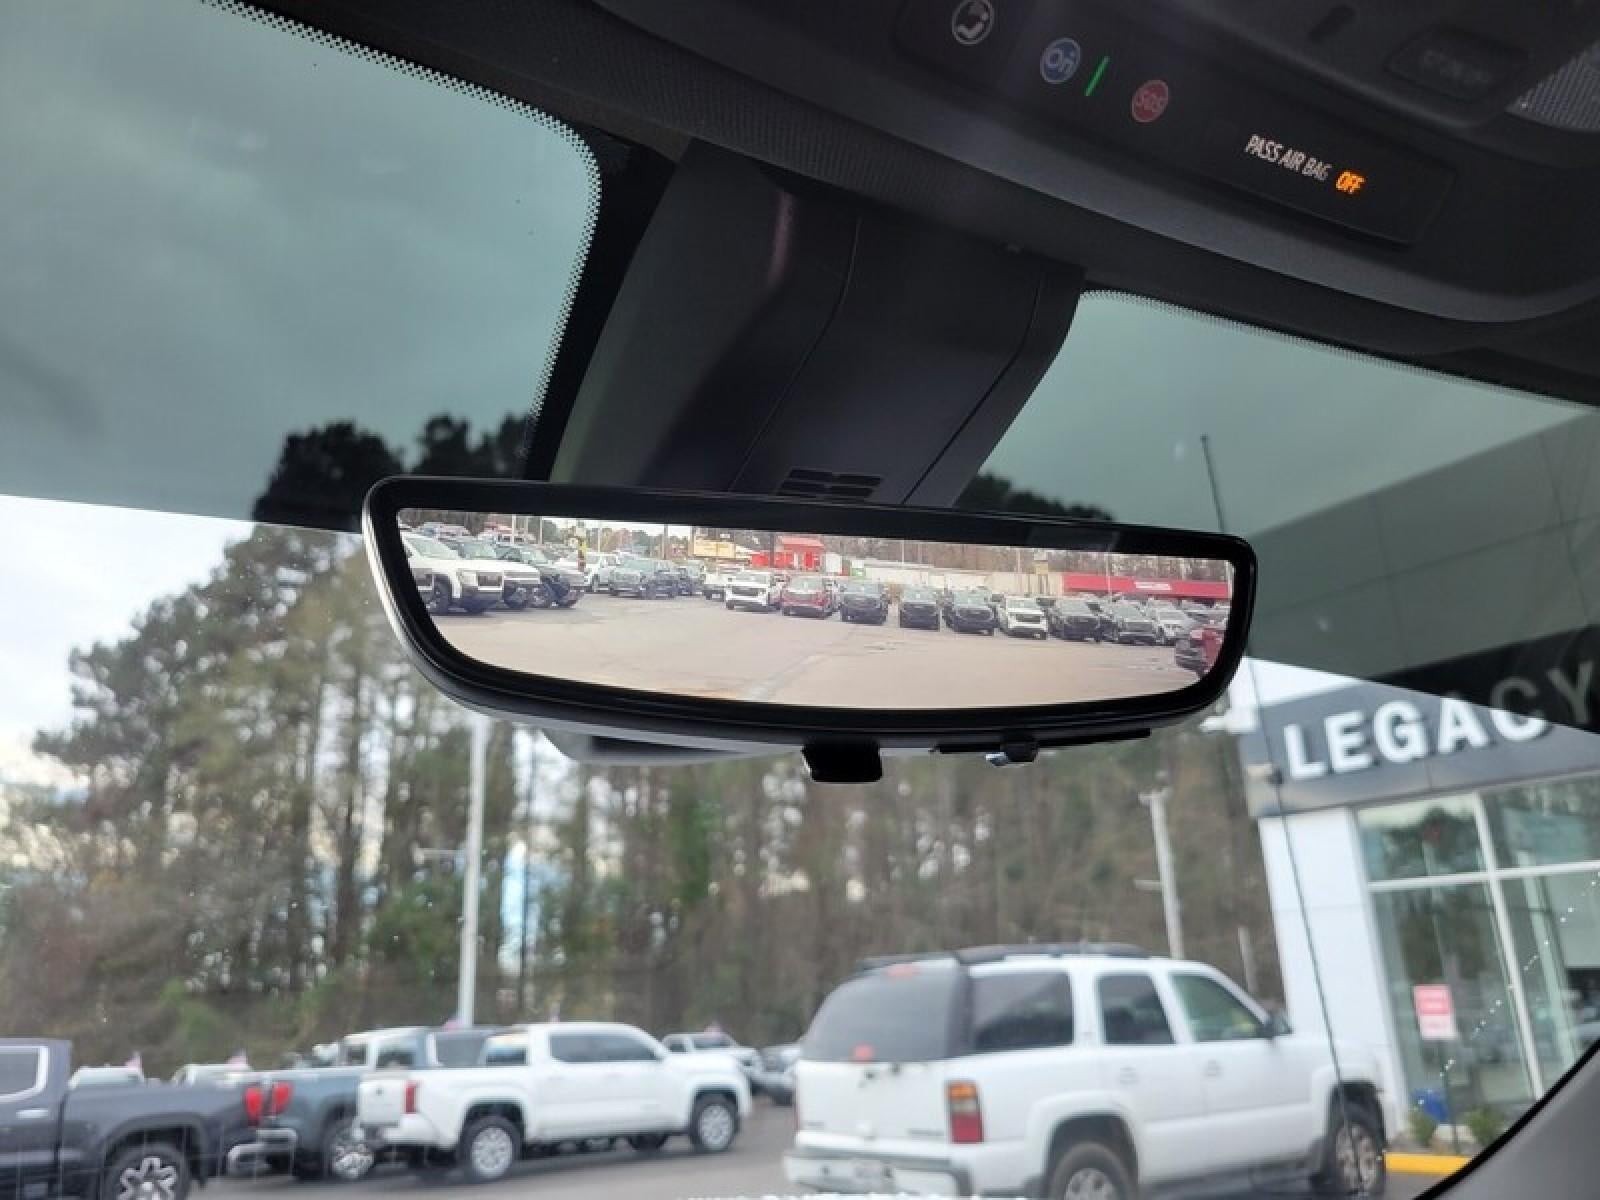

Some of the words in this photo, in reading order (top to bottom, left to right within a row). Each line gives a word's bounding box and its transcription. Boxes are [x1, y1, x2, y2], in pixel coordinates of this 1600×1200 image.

[1245, 134, 1283, 162] PASS
[1278, 148, 1306, 172] AIR
[1302, 157, 1332, 182] BAG
[1336, 171, 1365, 194] OFF
[1283, 661, 1593, 780] LEGACY
